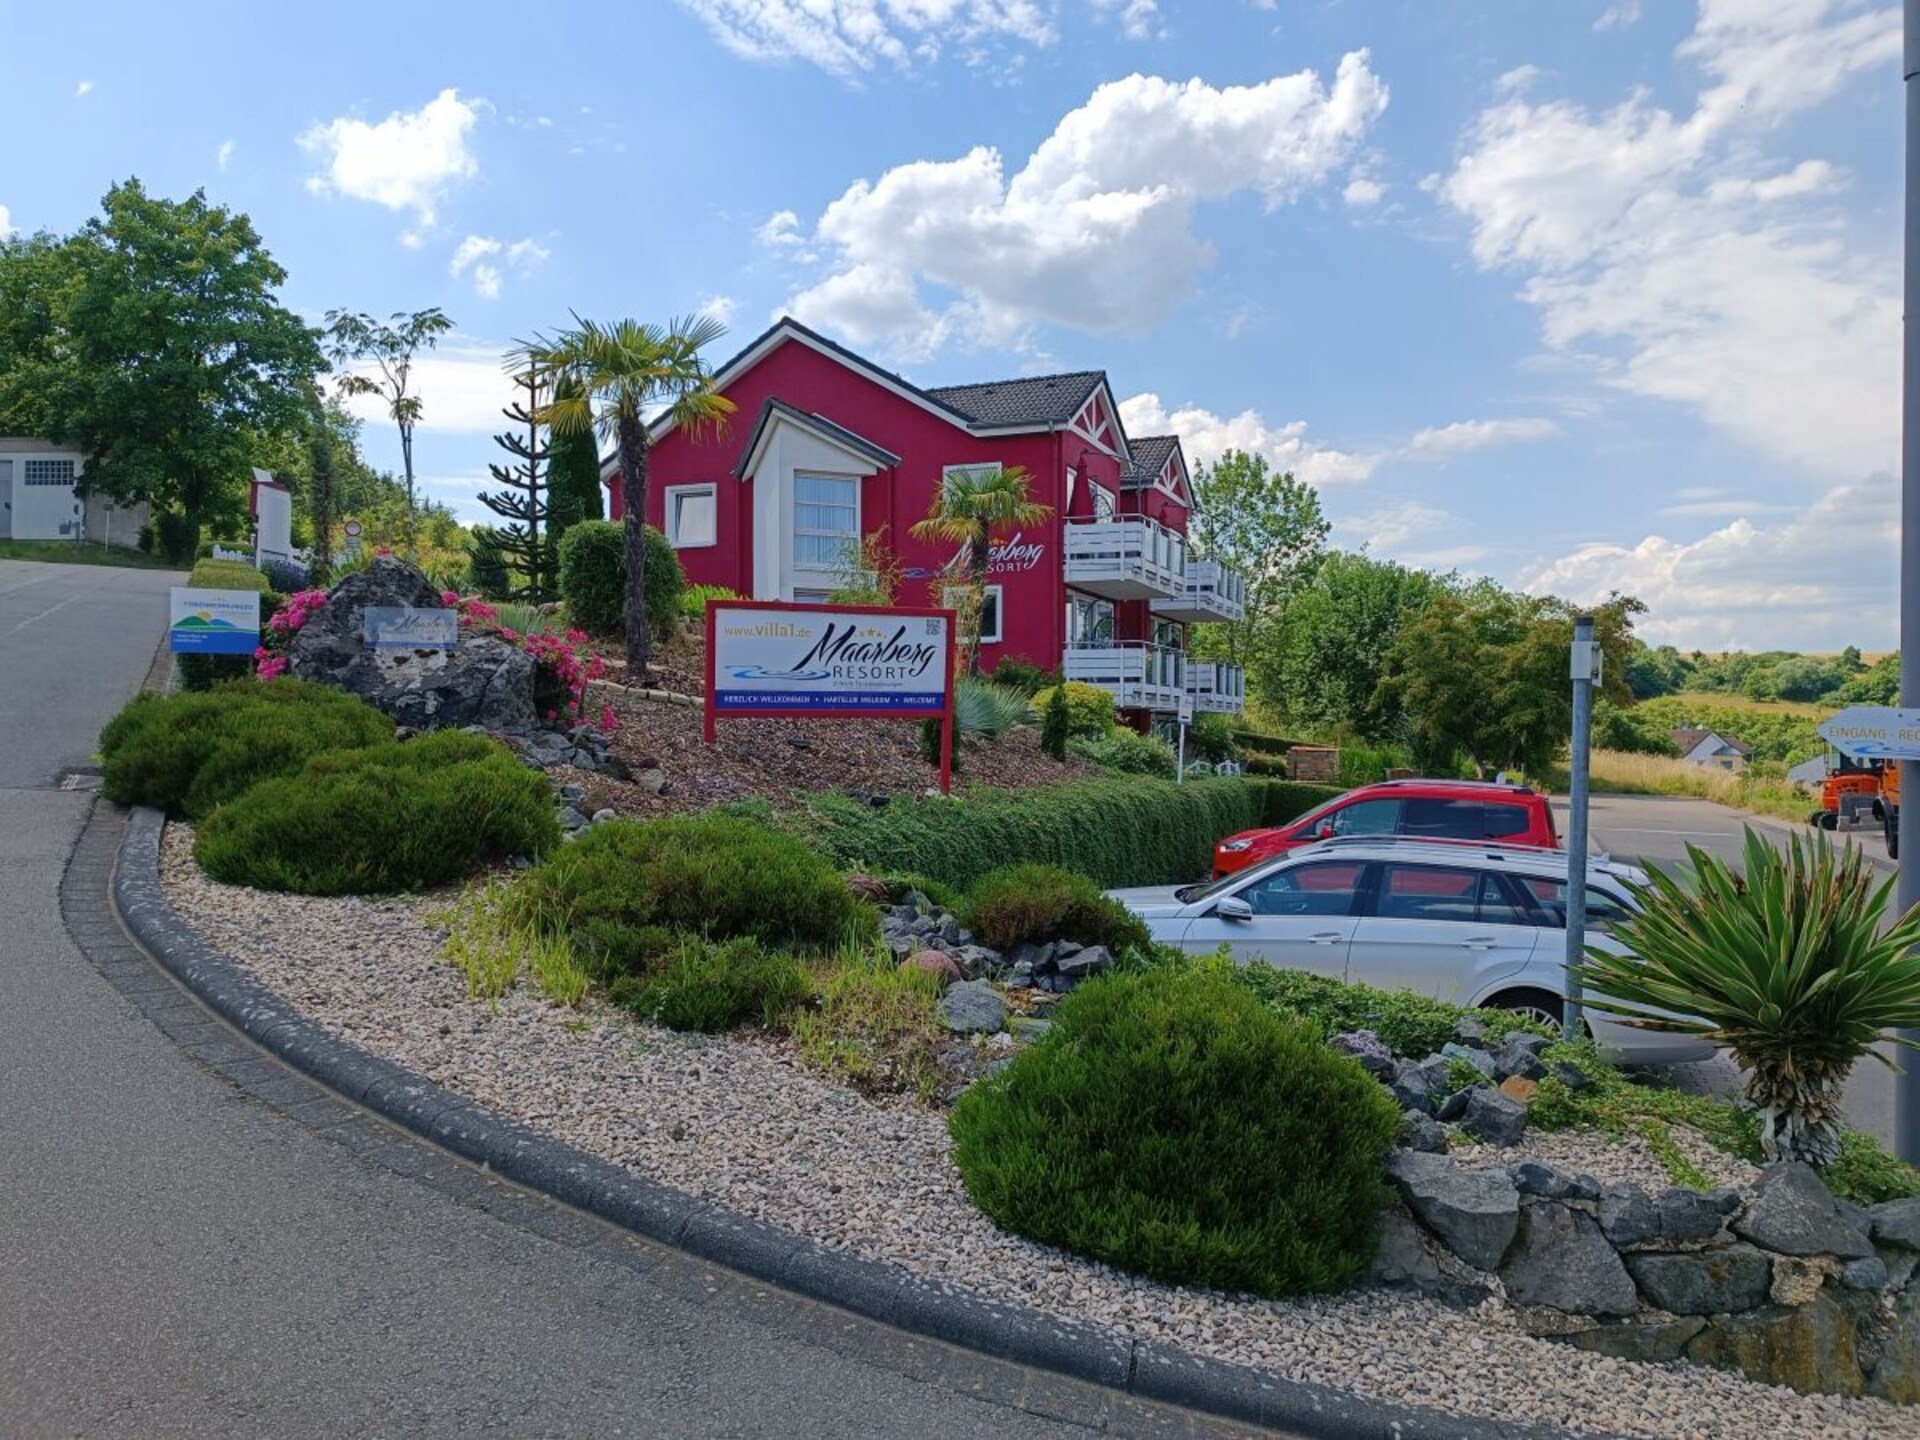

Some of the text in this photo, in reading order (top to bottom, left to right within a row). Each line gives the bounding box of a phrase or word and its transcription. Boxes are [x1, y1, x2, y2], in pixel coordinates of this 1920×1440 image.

[724, 621, 812, 638] www.villa1.de
[791, 622, 937, 677] Maarberg
[833, 665, 908, 679] RESORT
[724, 695, 758, 703] HERZLICH
[760, 696, 810, 704] WILLKOMMEN
[903, 697, 937, 705] WELCOME
[1829, 726, 1887, 739] EINGANG
